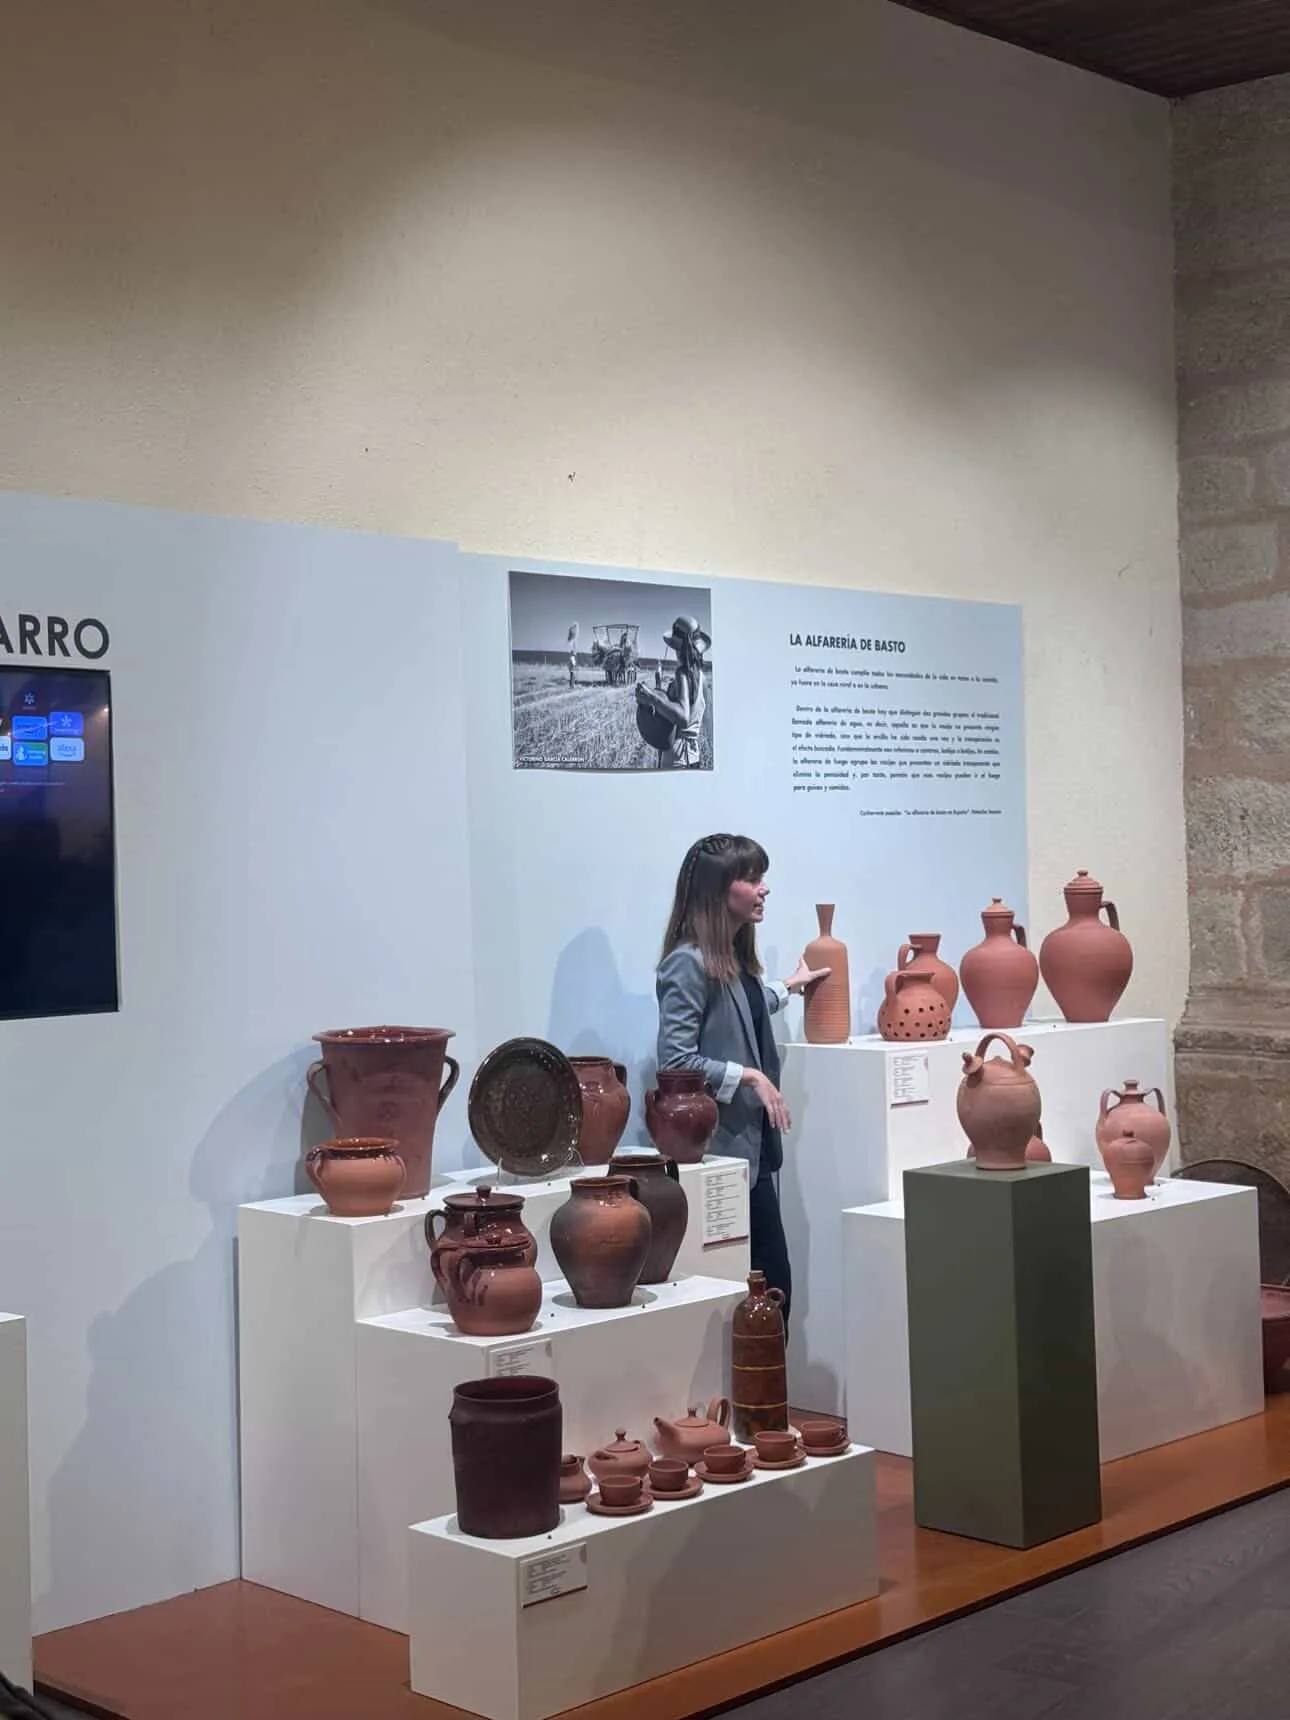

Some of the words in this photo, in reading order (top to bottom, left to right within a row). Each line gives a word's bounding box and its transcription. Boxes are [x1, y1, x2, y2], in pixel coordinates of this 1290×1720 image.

[790, 633, 802, 647] LA
[805, 634, 857, 650] ALFARERÍA
[860, 639, 872, 651] DE
[874, 640, 906, 653] BASTO
